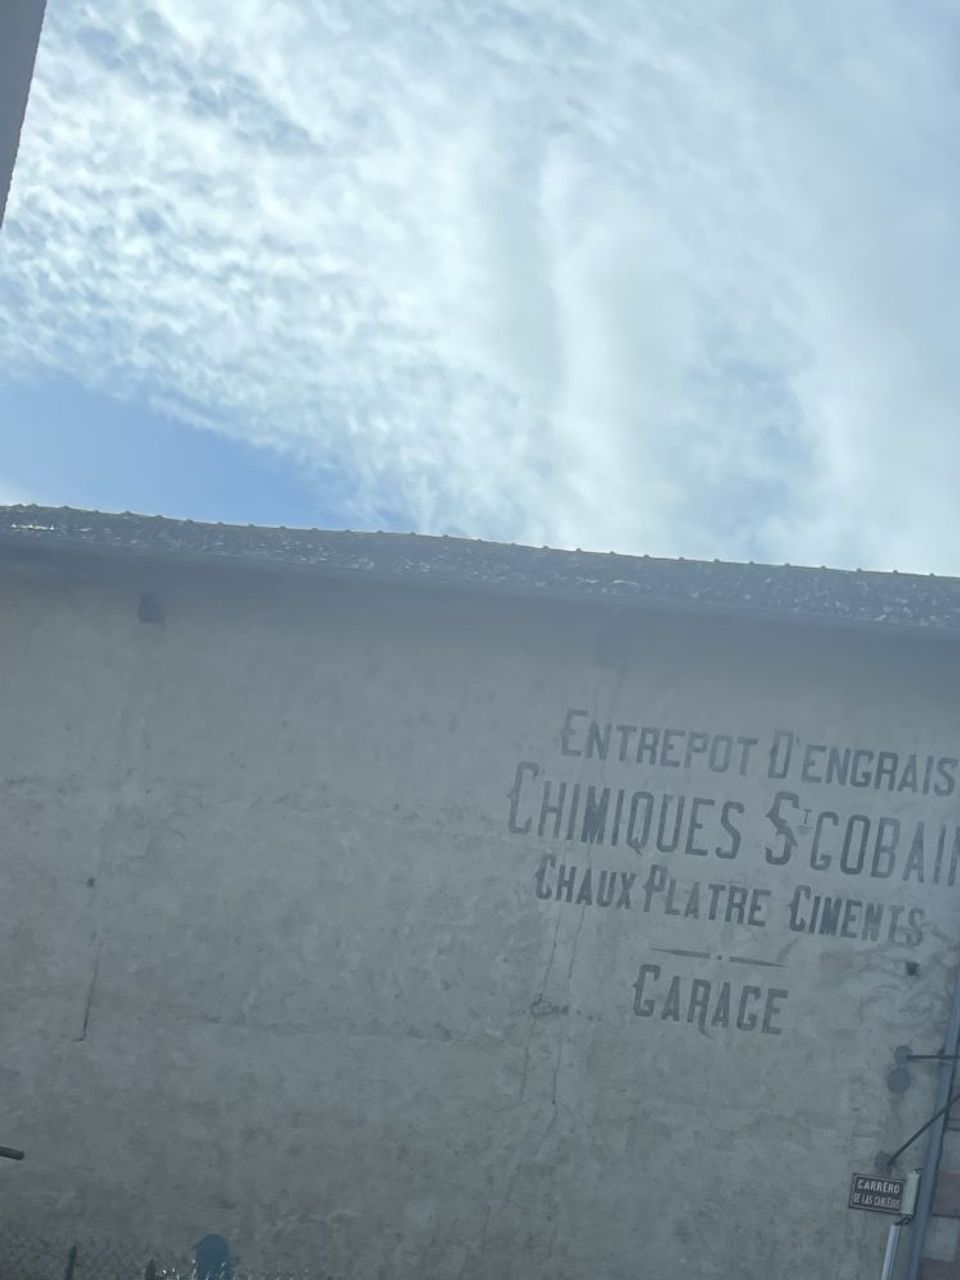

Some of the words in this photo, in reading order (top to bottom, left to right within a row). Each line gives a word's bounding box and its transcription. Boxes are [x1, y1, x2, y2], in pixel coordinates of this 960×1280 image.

[561, 708, 758, 775] ENTREPOT
[507, 761, 745, 859] CHIMIQUES
[535, 854, 637, 910] CHAUX
[643, 864, 772, 928] PLATRE
[789, 885, 926, 947] CIMENTS
[632, 963, 790, 1038] GARAGE
